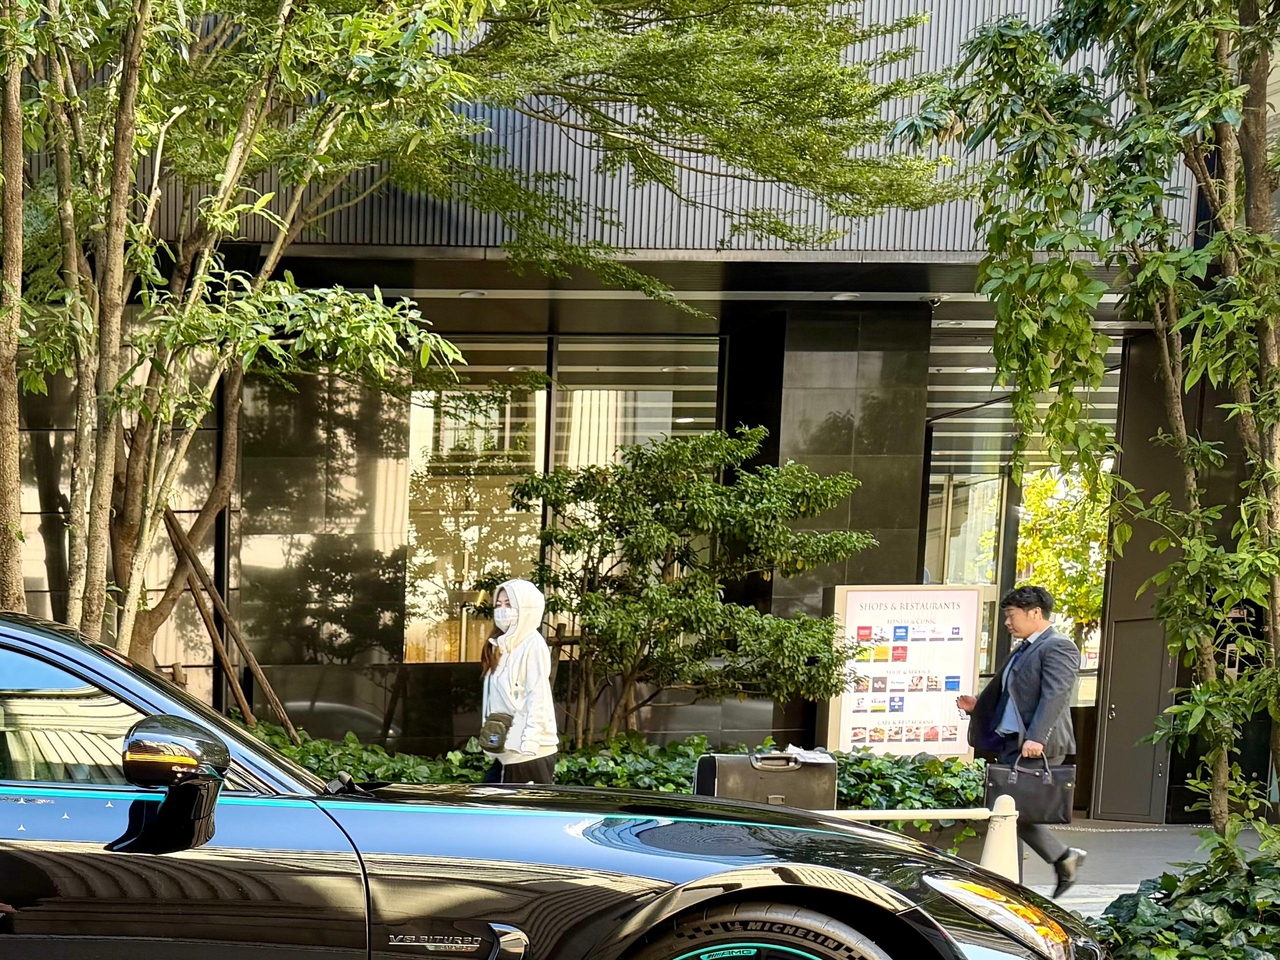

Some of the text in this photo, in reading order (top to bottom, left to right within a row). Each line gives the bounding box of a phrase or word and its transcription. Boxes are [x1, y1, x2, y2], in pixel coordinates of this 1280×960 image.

[859, 601, 961, 611] SHOPS & RESTAURANTS
[389, 934, 482, 945] V8 BITURBO
[747, 921, 839, 949] MICHELIN
